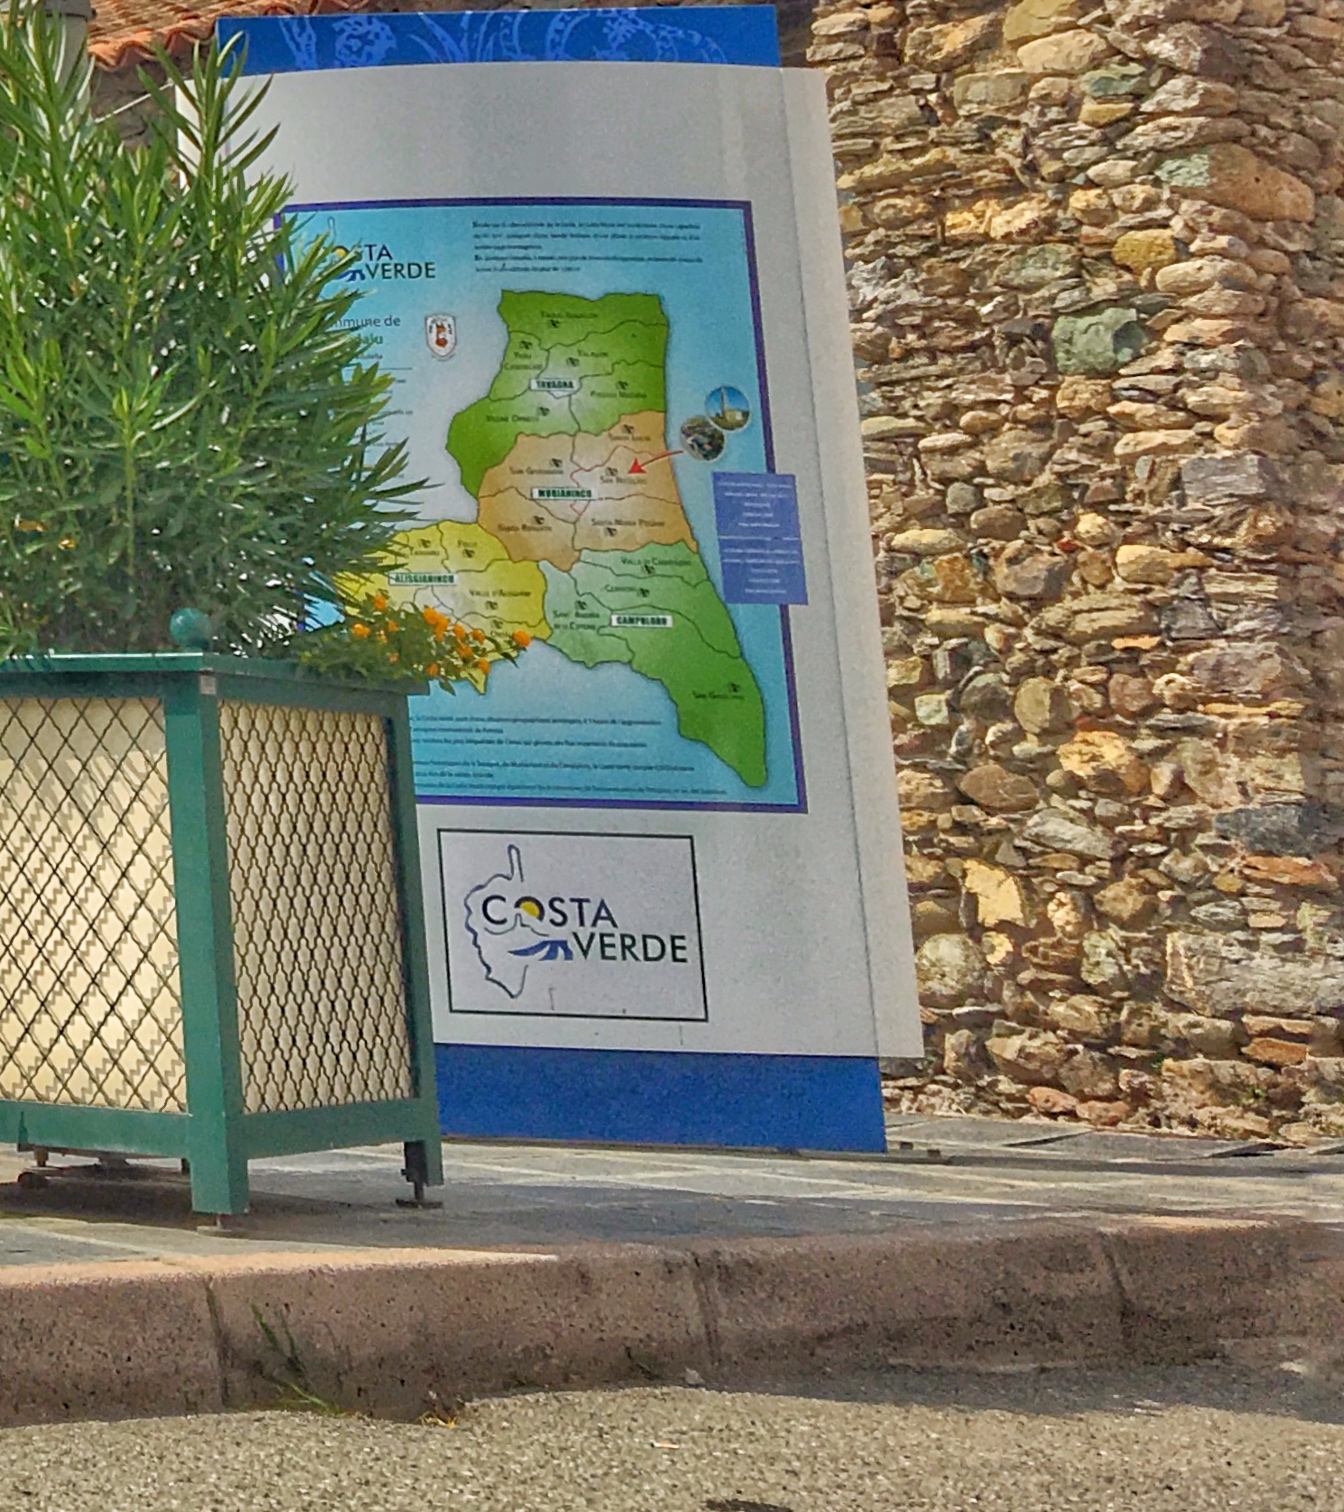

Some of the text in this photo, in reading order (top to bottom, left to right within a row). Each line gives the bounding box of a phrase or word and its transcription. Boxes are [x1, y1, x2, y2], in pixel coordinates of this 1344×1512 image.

[365, 262, 436, 279] VERDE
[384, 314, 401, 327] de
[482, 895, 619, 928] COSTA
[572, 932, 688, 963] VERDE
